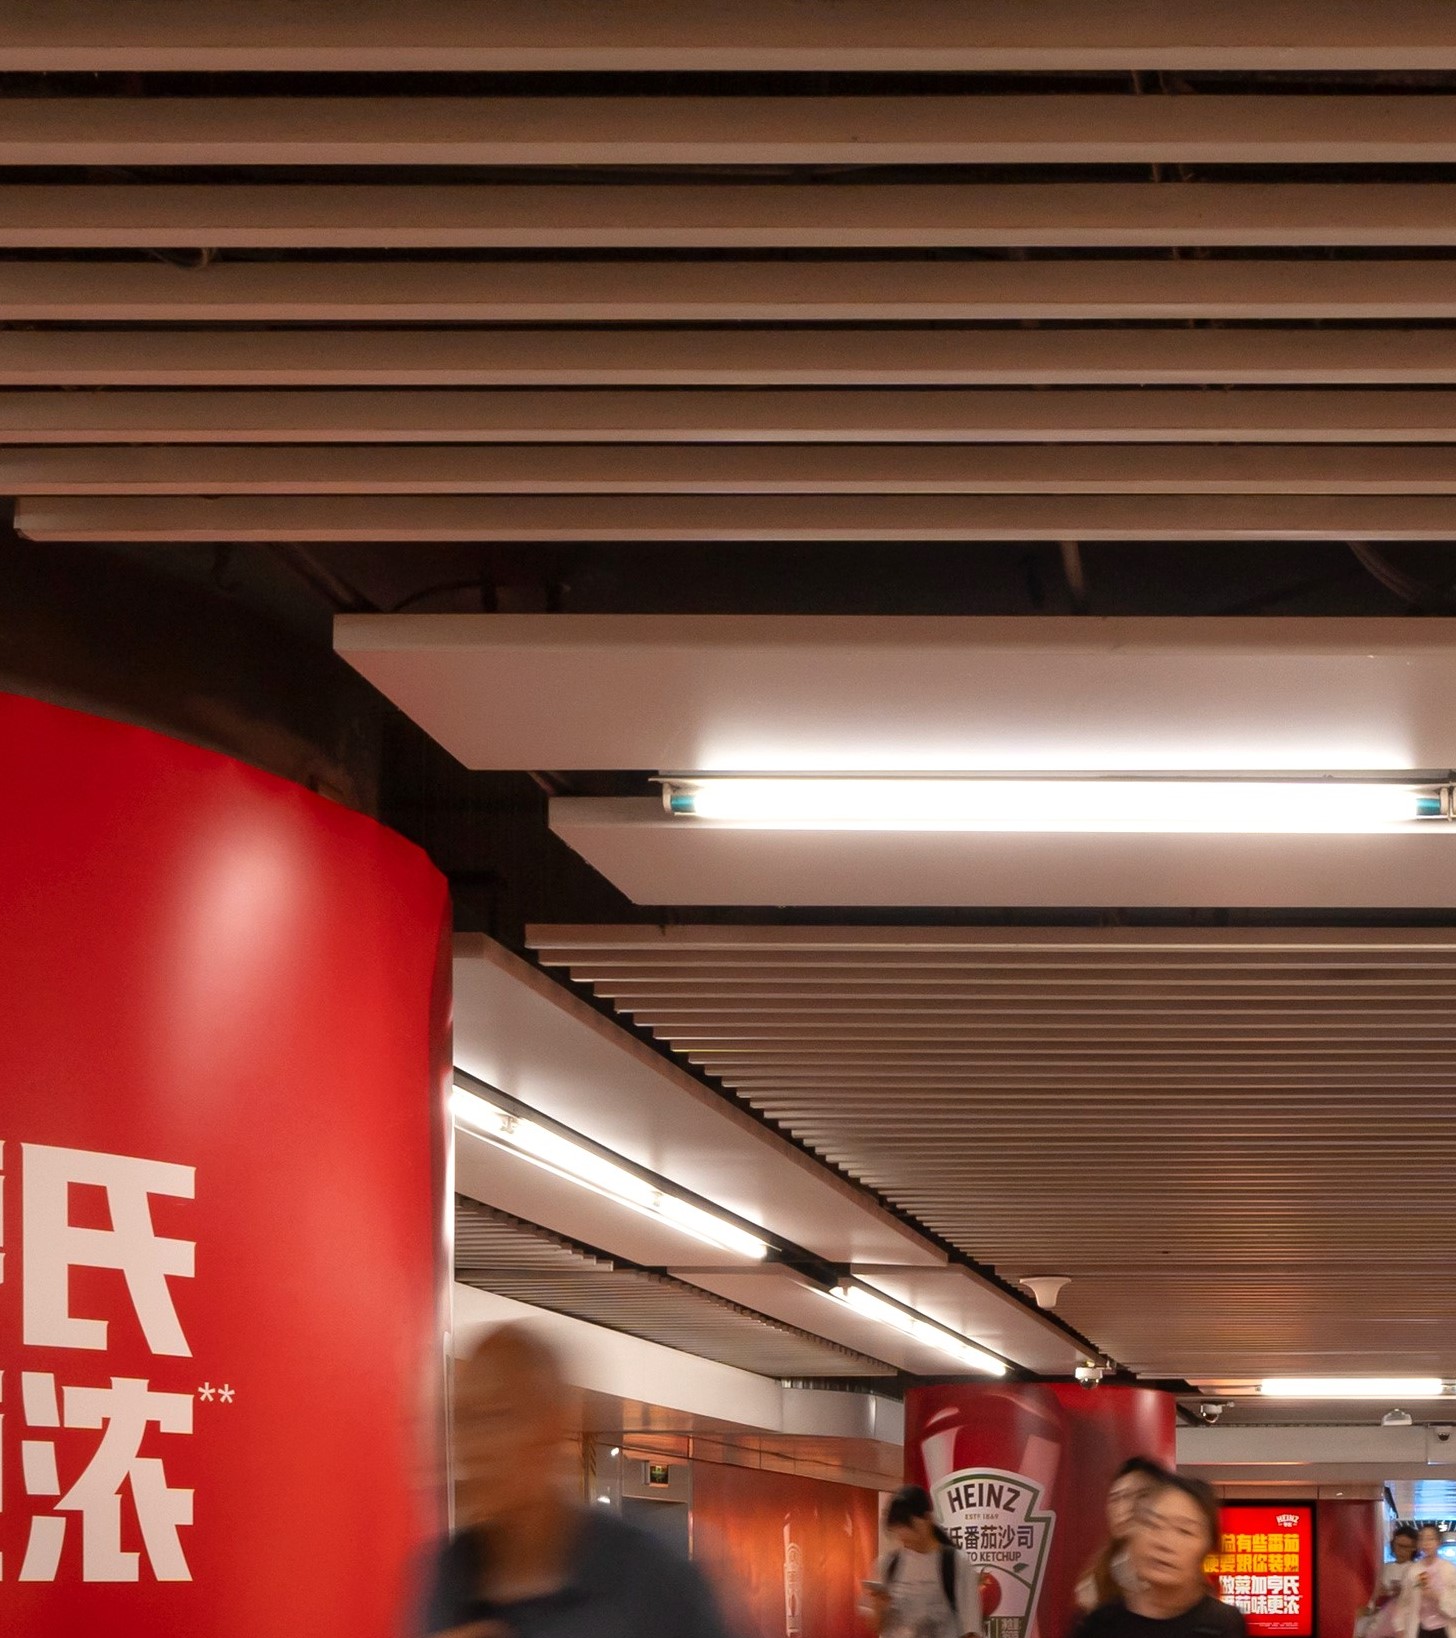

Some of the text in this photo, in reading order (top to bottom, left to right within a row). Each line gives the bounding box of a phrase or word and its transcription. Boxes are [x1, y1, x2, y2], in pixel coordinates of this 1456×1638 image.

[946, 1482, 1021, 1514] HEINZ
[944, 1524, 1035, 1550] 氏番茄沙司
[979, 1551, 1022, 1562] KETCHUP
